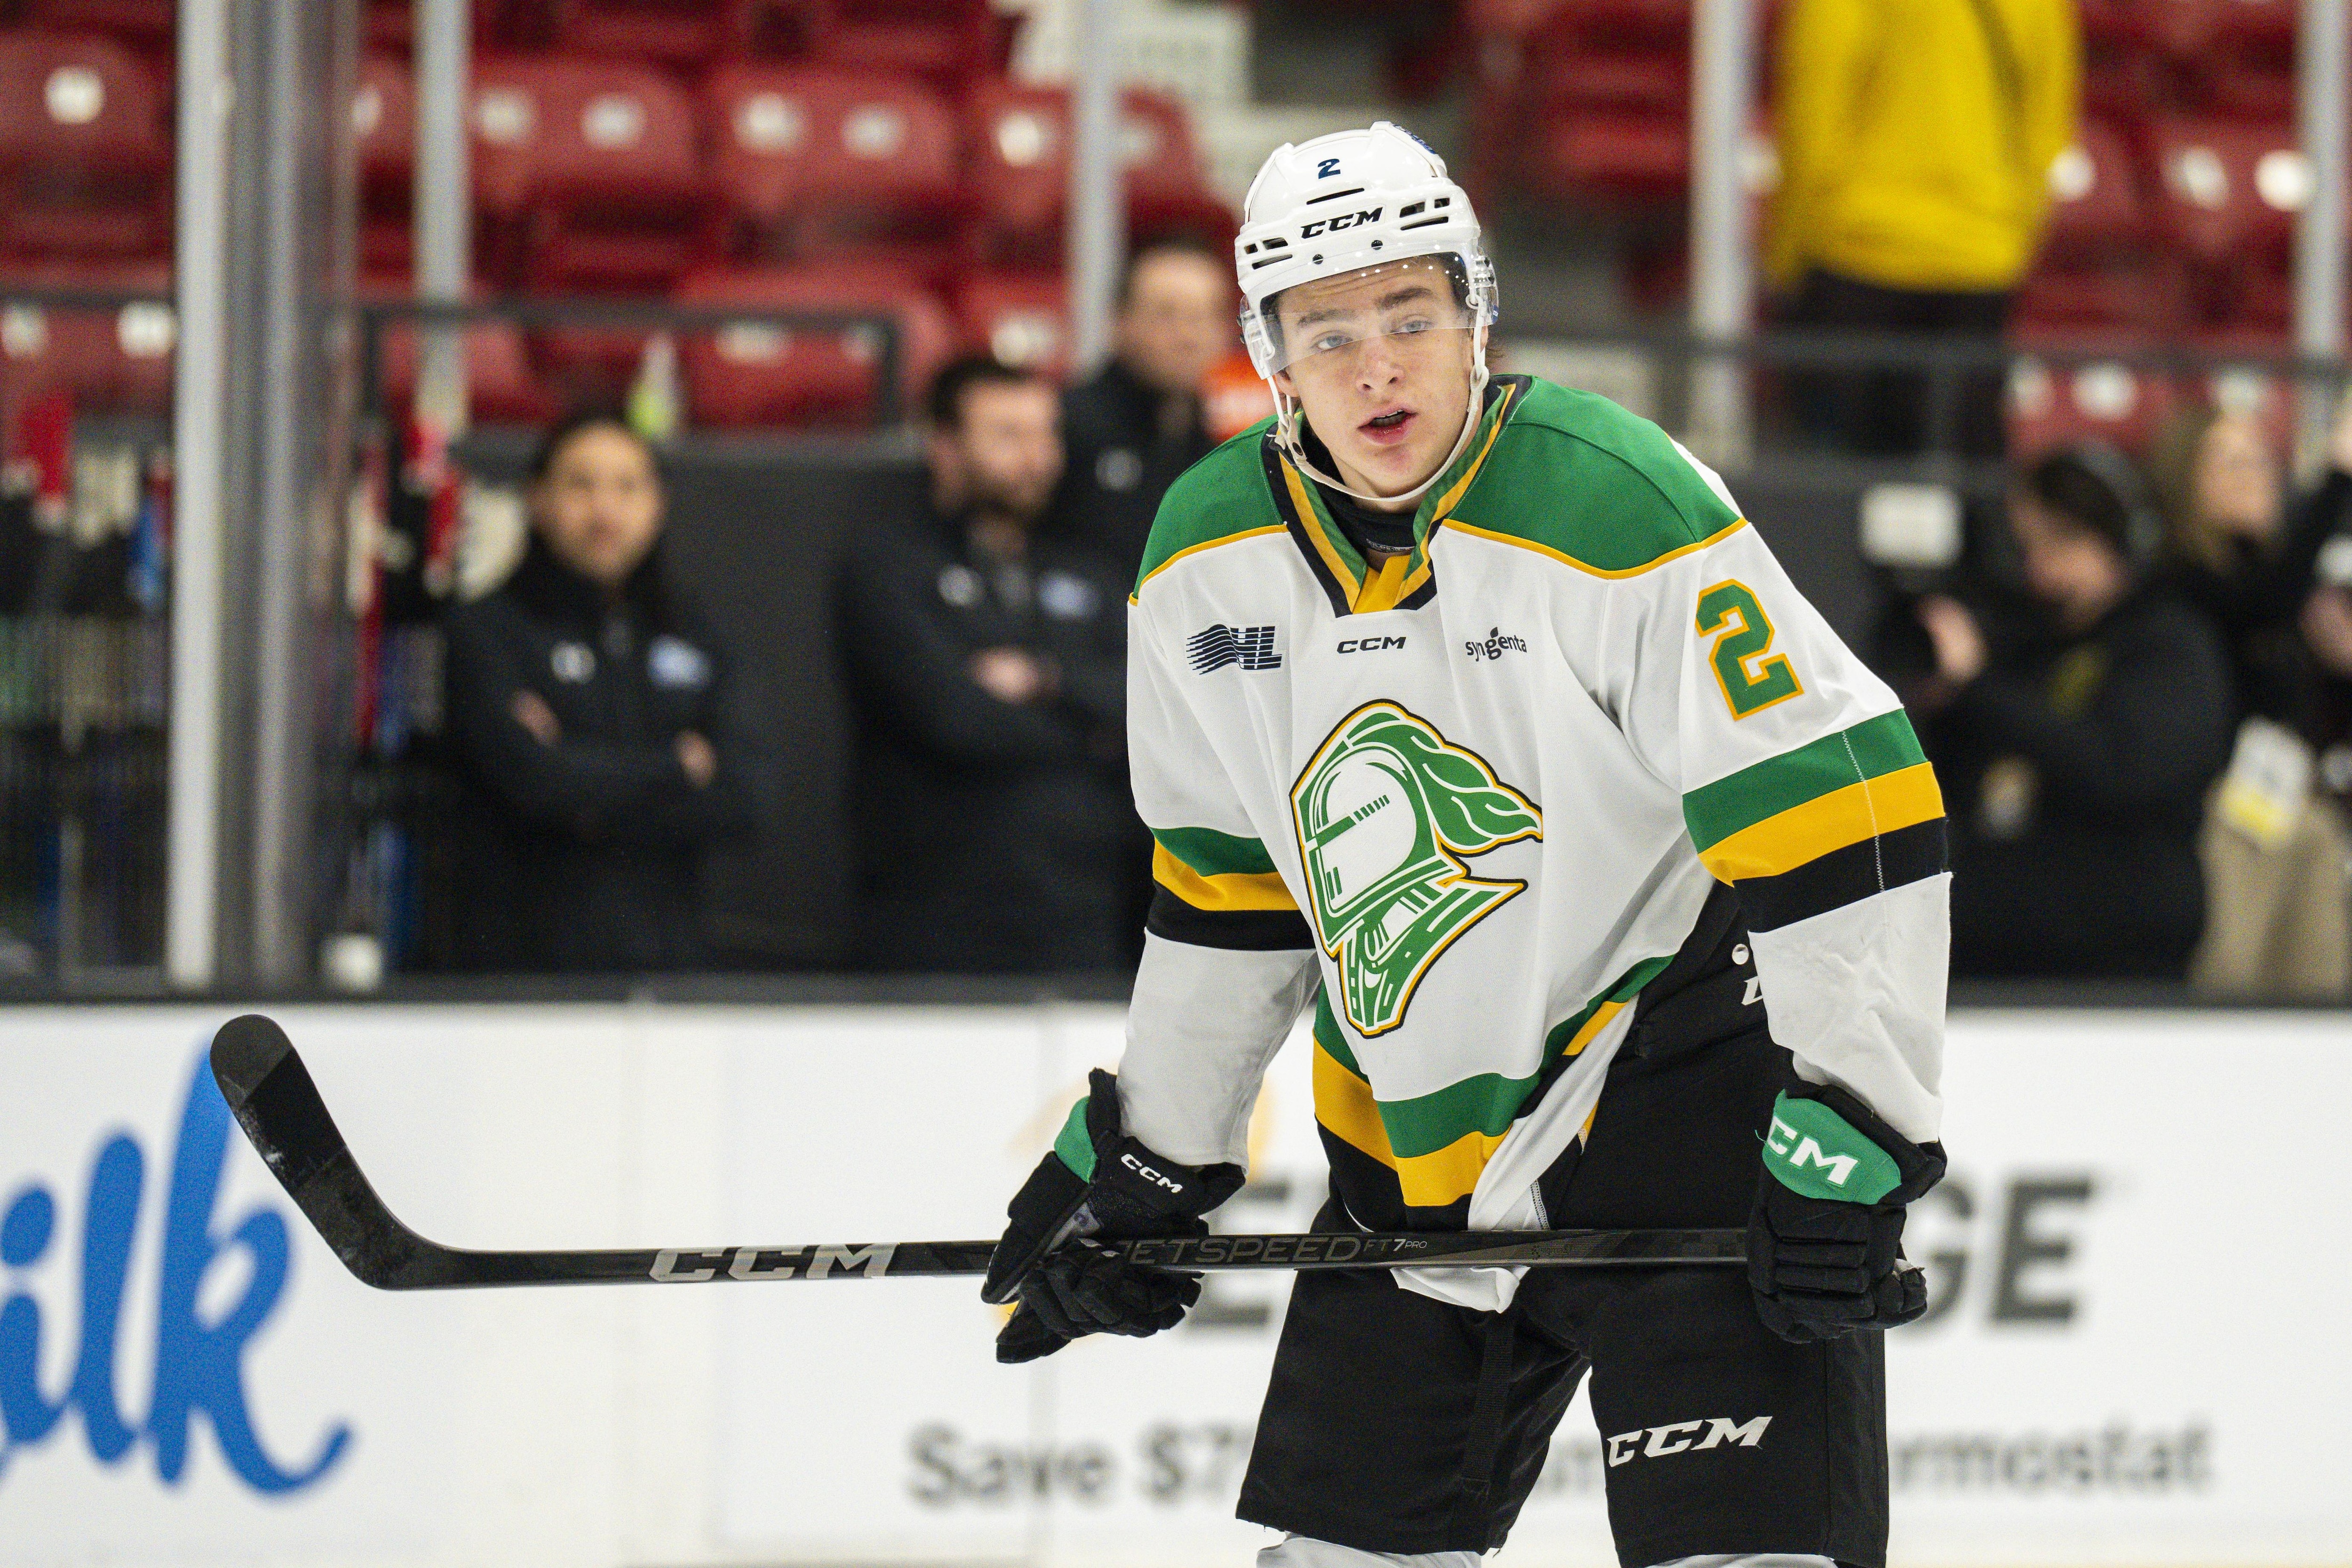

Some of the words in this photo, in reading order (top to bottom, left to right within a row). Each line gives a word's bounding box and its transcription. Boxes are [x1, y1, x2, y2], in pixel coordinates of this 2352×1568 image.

[1318, 158, 1341, 179] 2
[1300, 207, 1383, 239] CCM
[1336, 637, 1406, 654] CCM
[1465, 630, 1527, 662] syngenta
[1694, 579, 1804, 721] 2
[1121, 1153, 1183, 1194] CCM
[1767, 1115, 1859, 1187] CM
[0, 1033, 352, 1494] ilk
[649, 1242, 899, 1281] CCM
[907, 1422, 1111, 1505] Save
[1136, 1422, 1255, 1505] $7
[1607, 1416, 1773, 1467] CCM
[1890, 1416, 2213, 1495] rmostat
